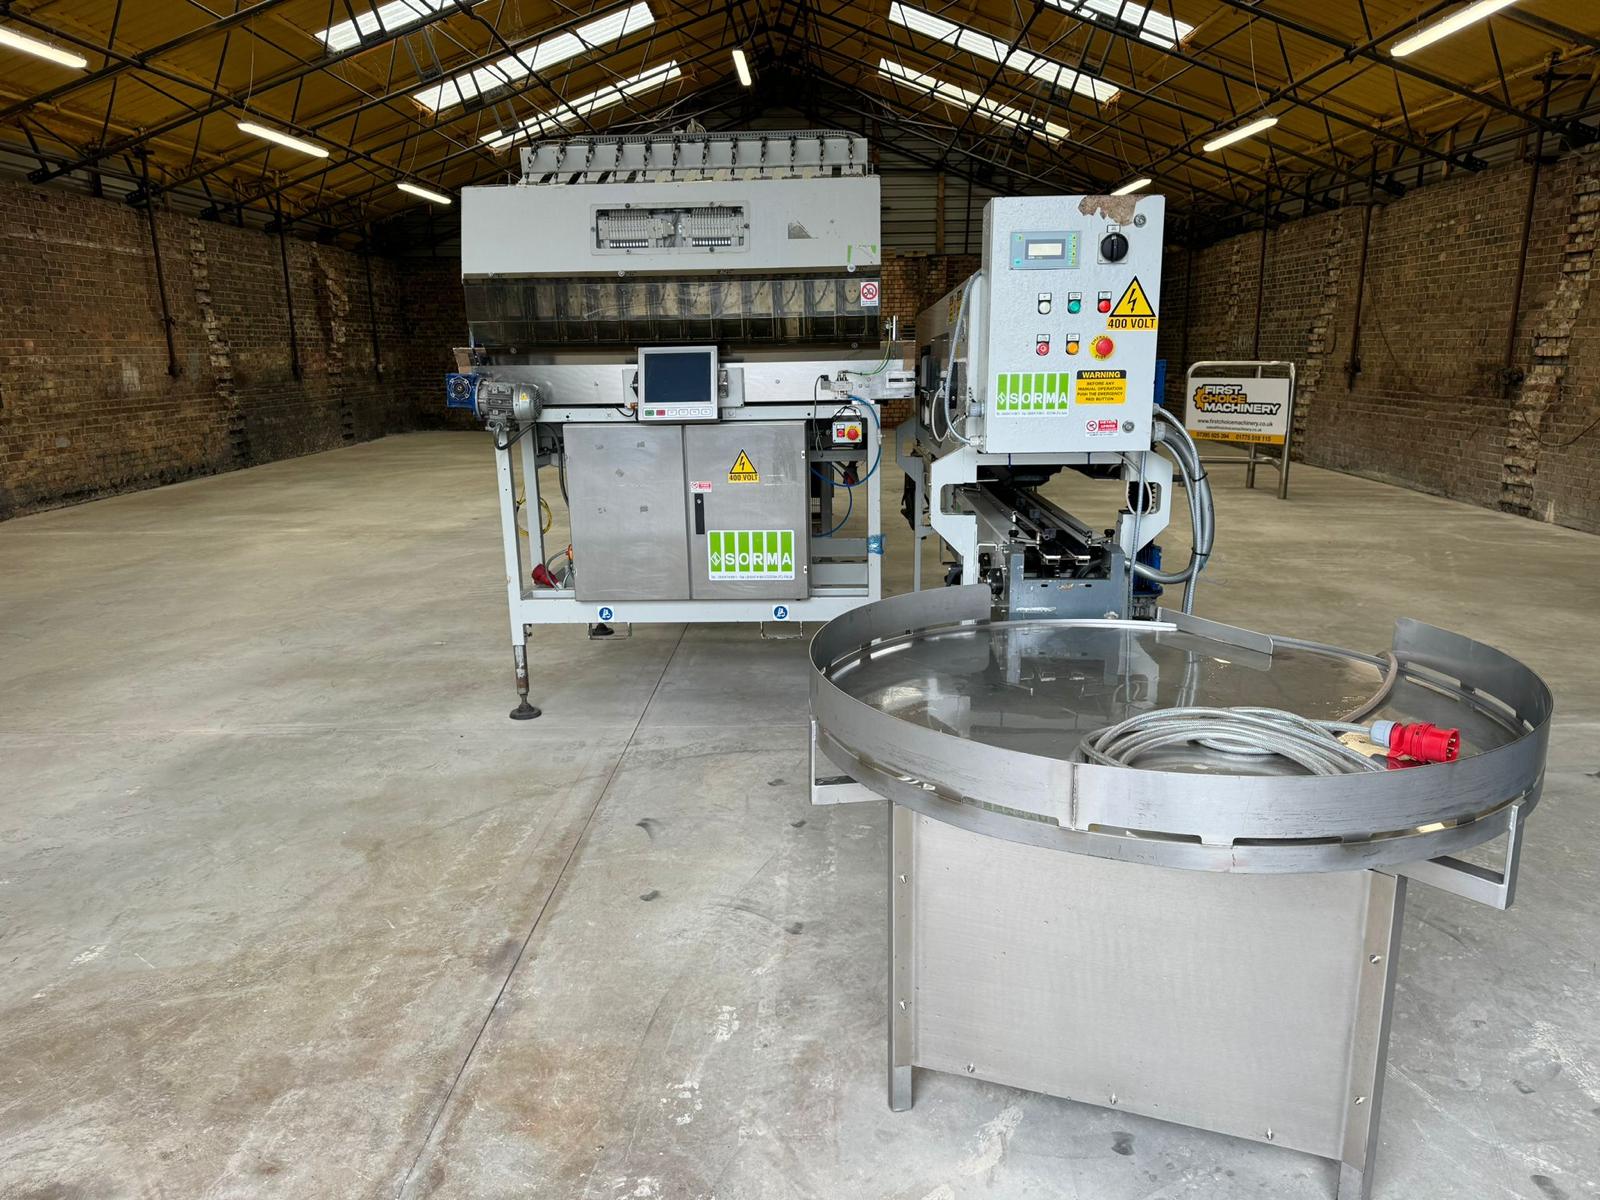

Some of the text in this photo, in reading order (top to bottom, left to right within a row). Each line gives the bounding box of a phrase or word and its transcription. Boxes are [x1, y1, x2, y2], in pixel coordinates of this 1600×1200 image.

[1108, 319, 1156, 329] 400 VOLT
[1206, 386, 1241, 394] FIRST
[1010, 392, 1067, 404] SORMA
[1201, 394, 1246, 403] CHOICE
[1204, 403, 1279, 414] MACHINERY
[725, 552, 792, 565] SORMA
